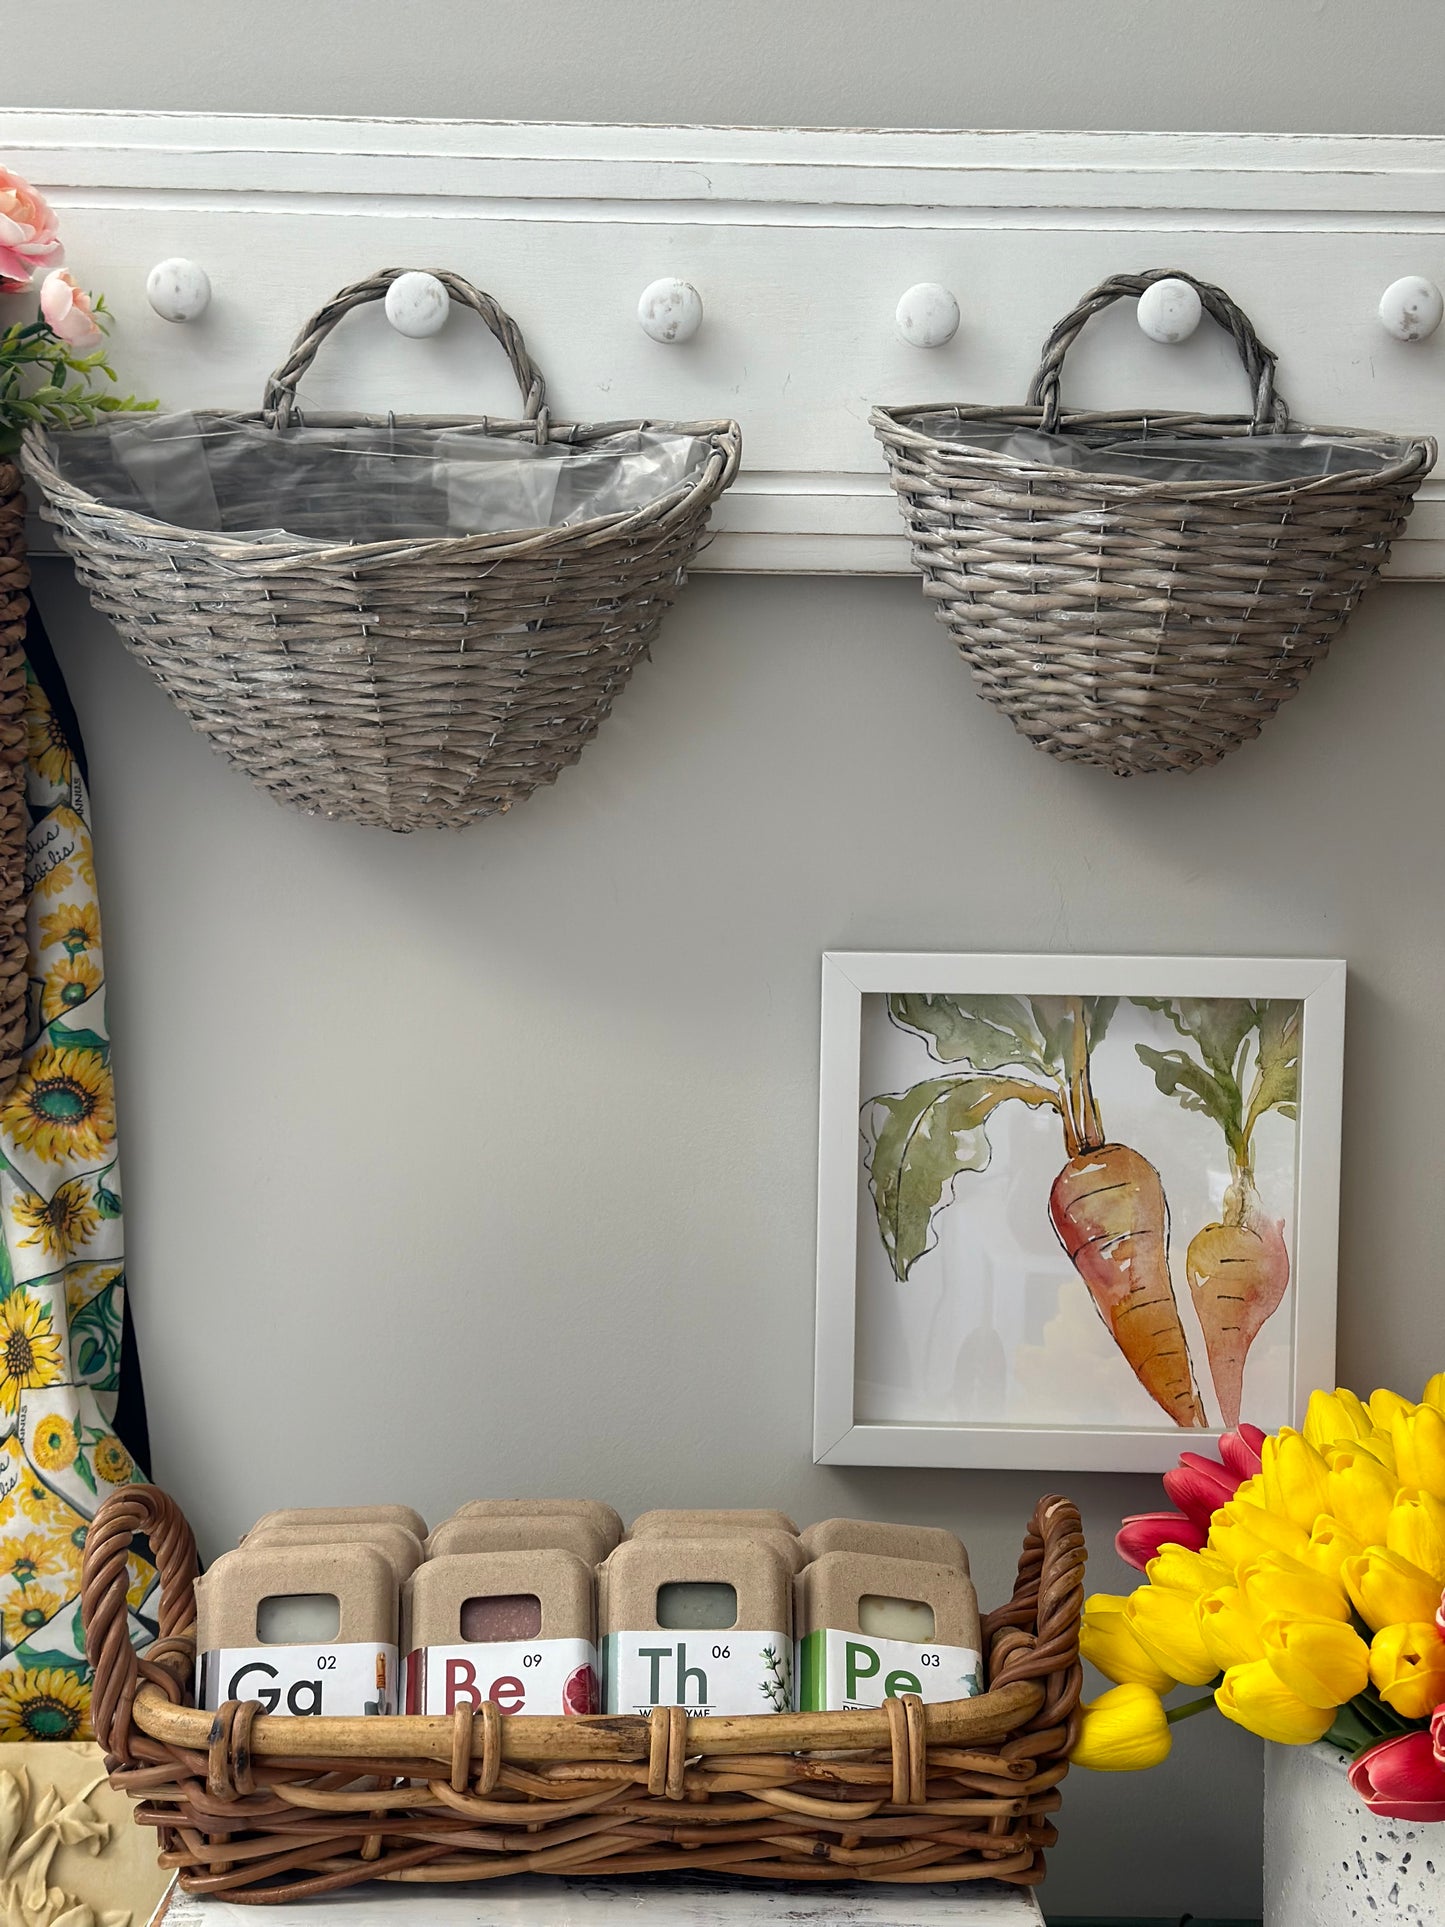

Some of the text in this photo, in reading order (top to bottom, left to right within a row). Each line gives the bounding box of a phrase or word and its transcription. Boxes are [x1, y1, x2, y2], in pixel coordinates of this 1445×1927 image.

[317, 1655, 337, 1670] 02
[522, 1654, 542, 1668] 09
[711, 1645, 731, 1659] 06
[920, 1654, 941, 1668] 03
[445, 1658, 526, 1716] Be
[638, 1643, 708, 1705] Th
[845, 1642, 923, 1701] Pe
[228, 1662, 323, 1716] Ga
